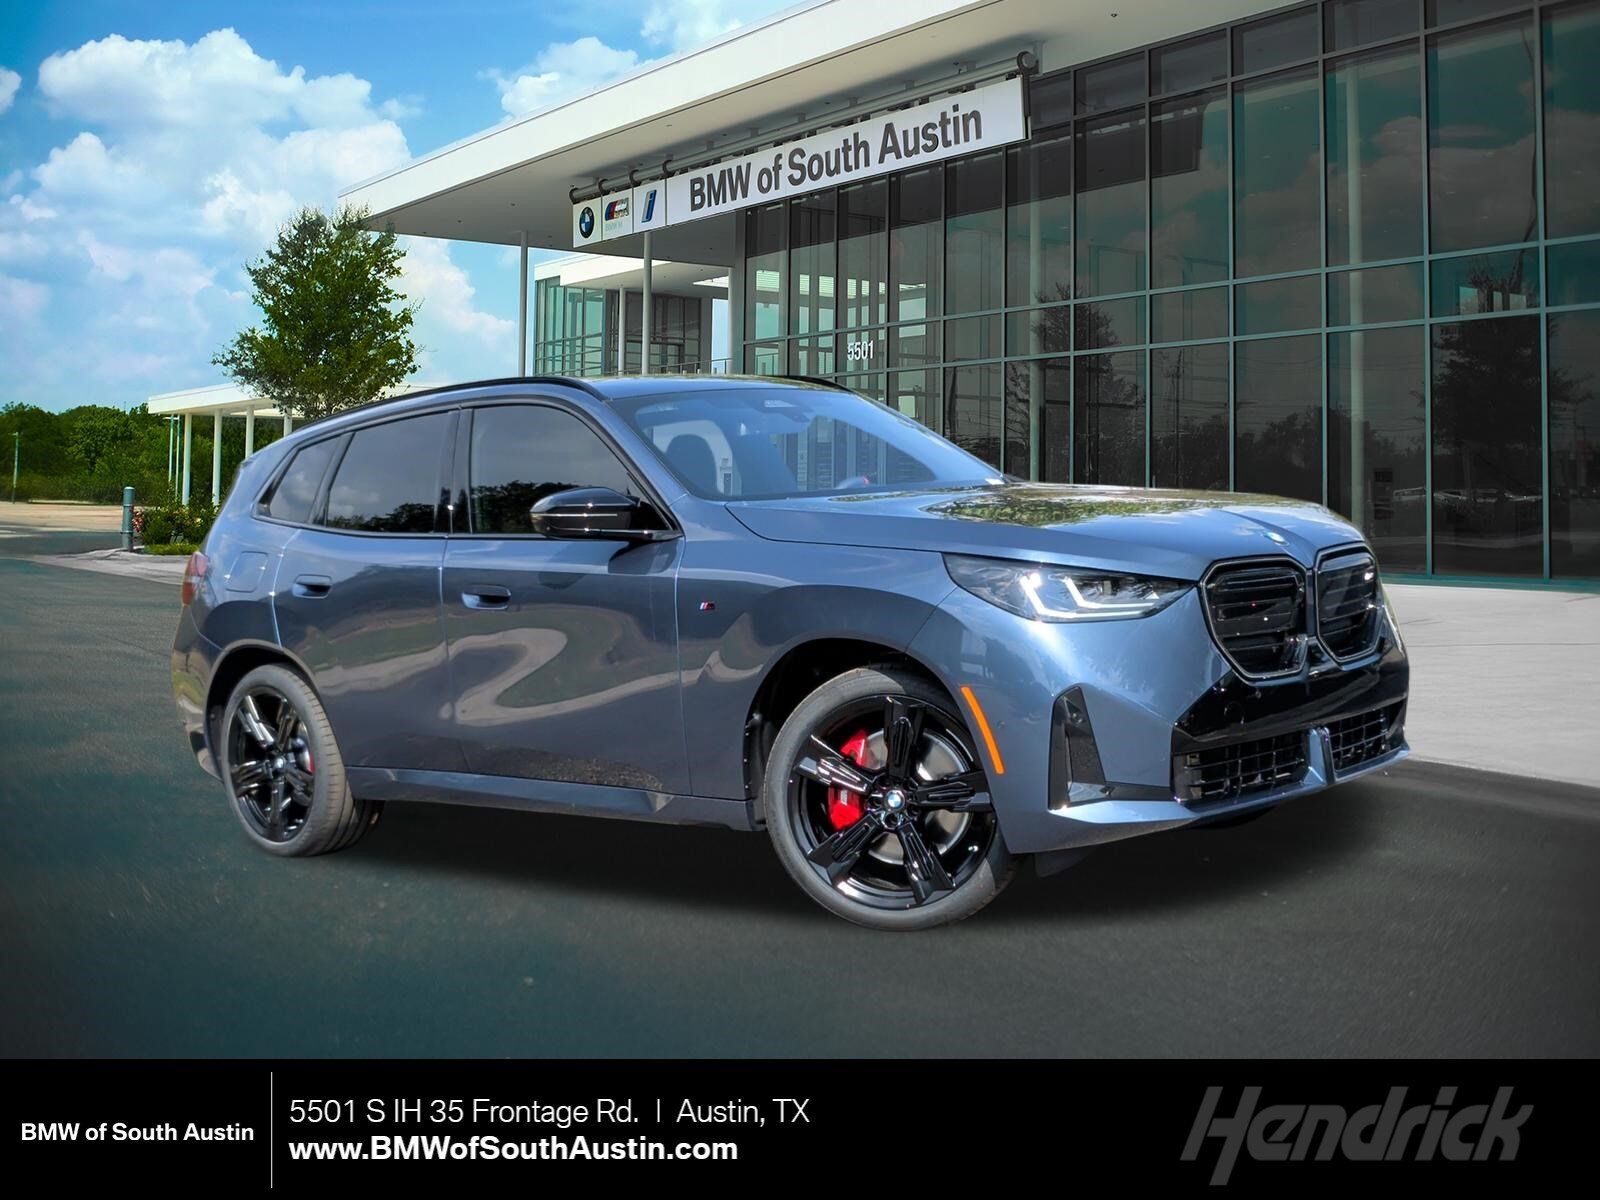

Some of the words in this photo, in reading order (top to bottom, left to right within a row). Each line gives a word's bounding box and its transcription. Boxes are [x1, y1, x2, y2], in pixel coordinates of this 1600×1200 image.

[689, 161, 752, 212] BMW
[757, 152, 783, 195] of
[787, 131, 871, 187] South
[877, 103, 982, 165] Austin
[847, 340, 874, 360] 5501
